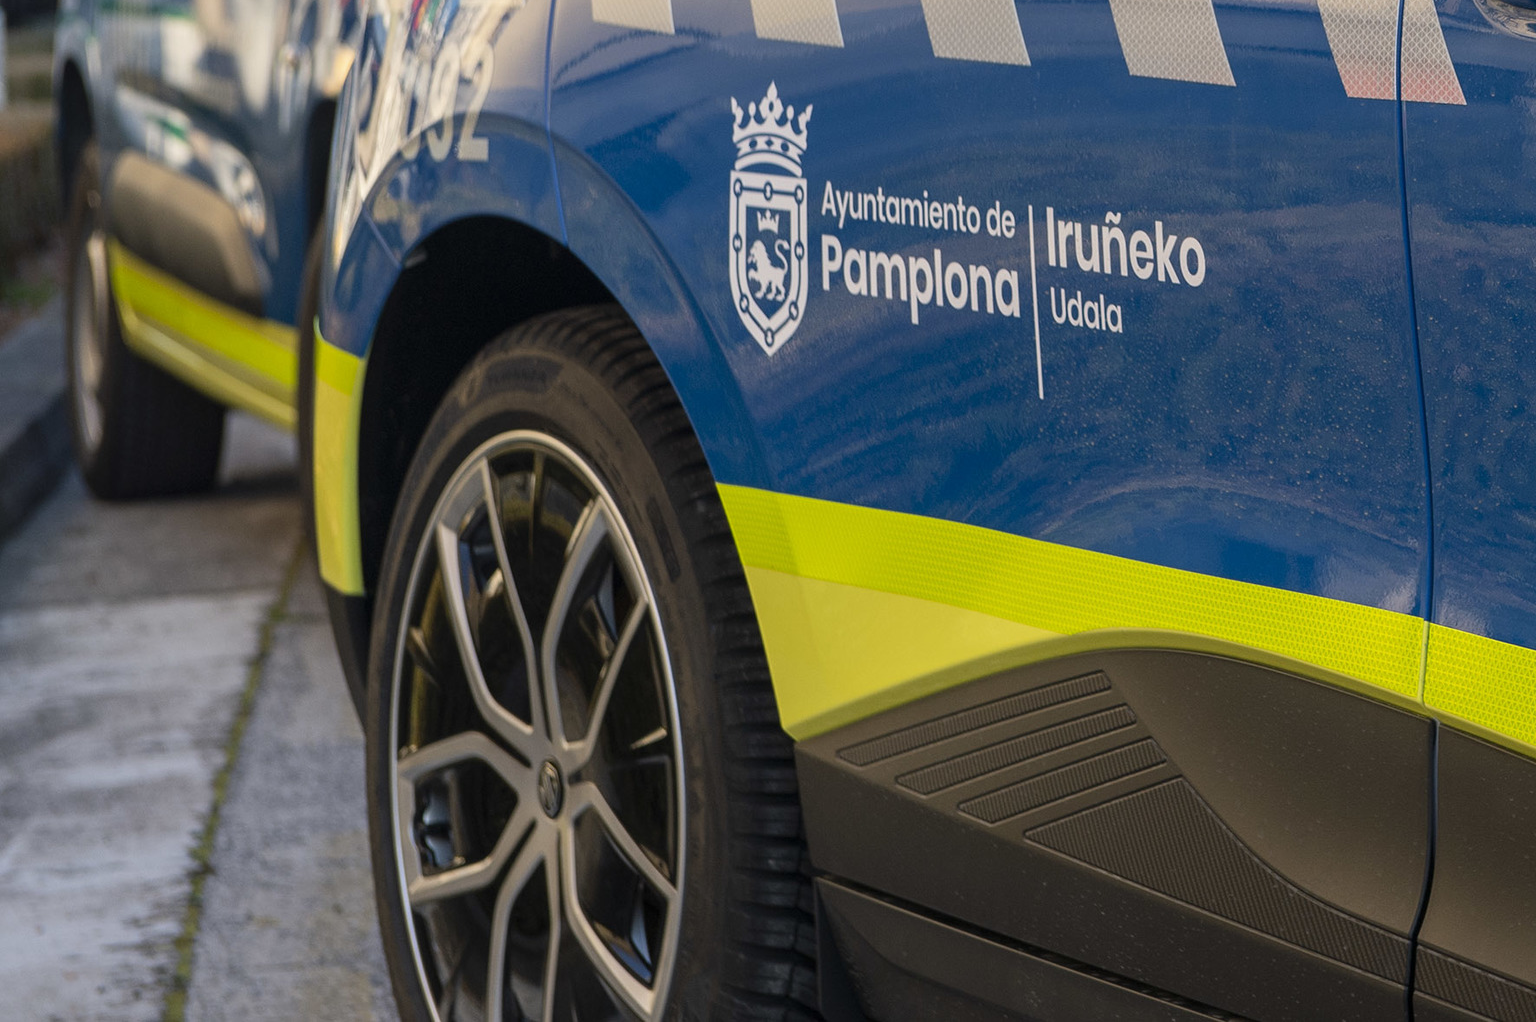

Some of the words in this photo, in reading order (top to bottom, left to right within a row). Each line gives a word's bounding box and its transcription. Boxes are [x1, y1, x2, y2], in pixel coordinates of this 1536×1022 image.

[821, 180, 981, 235] Ayuntamiento
[986, 200, 1016, 238] de
[821, 234, 1021, 325] Pamplona
[1046, 206, 1206, 287] Iruñeko
[1051, 286, 1124, 333] Udala
